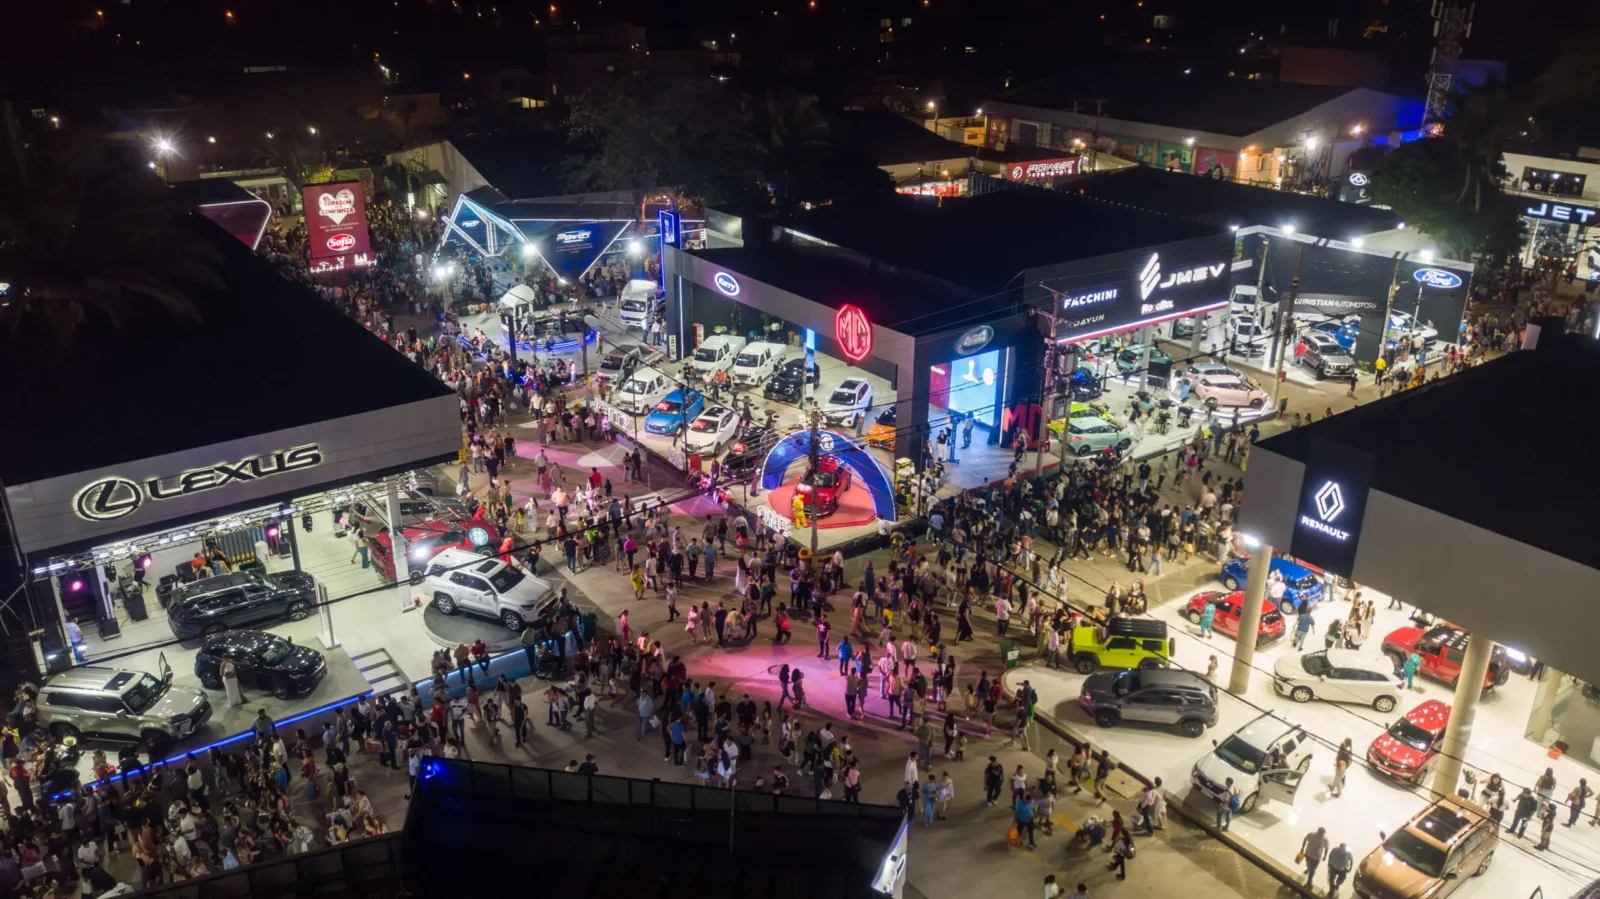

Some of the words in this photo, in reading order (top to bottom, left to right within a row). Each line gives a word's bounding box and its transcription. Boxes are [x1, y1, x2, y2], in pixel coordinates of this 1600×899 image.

[1027, 161, 1075, 174] POWER
[321, 207, 354, 215] CONFIANZA
[1527, 203, 1596, 222] JET
[1159, 263, 1226, 288] JMEV
[1063, 289, 1118, 309] FACCHINI
[839, 309, 870, 355] MG
[147, 443, 322, 500] LEXUS
[1302, 515, 1350, 540] RENAULT
